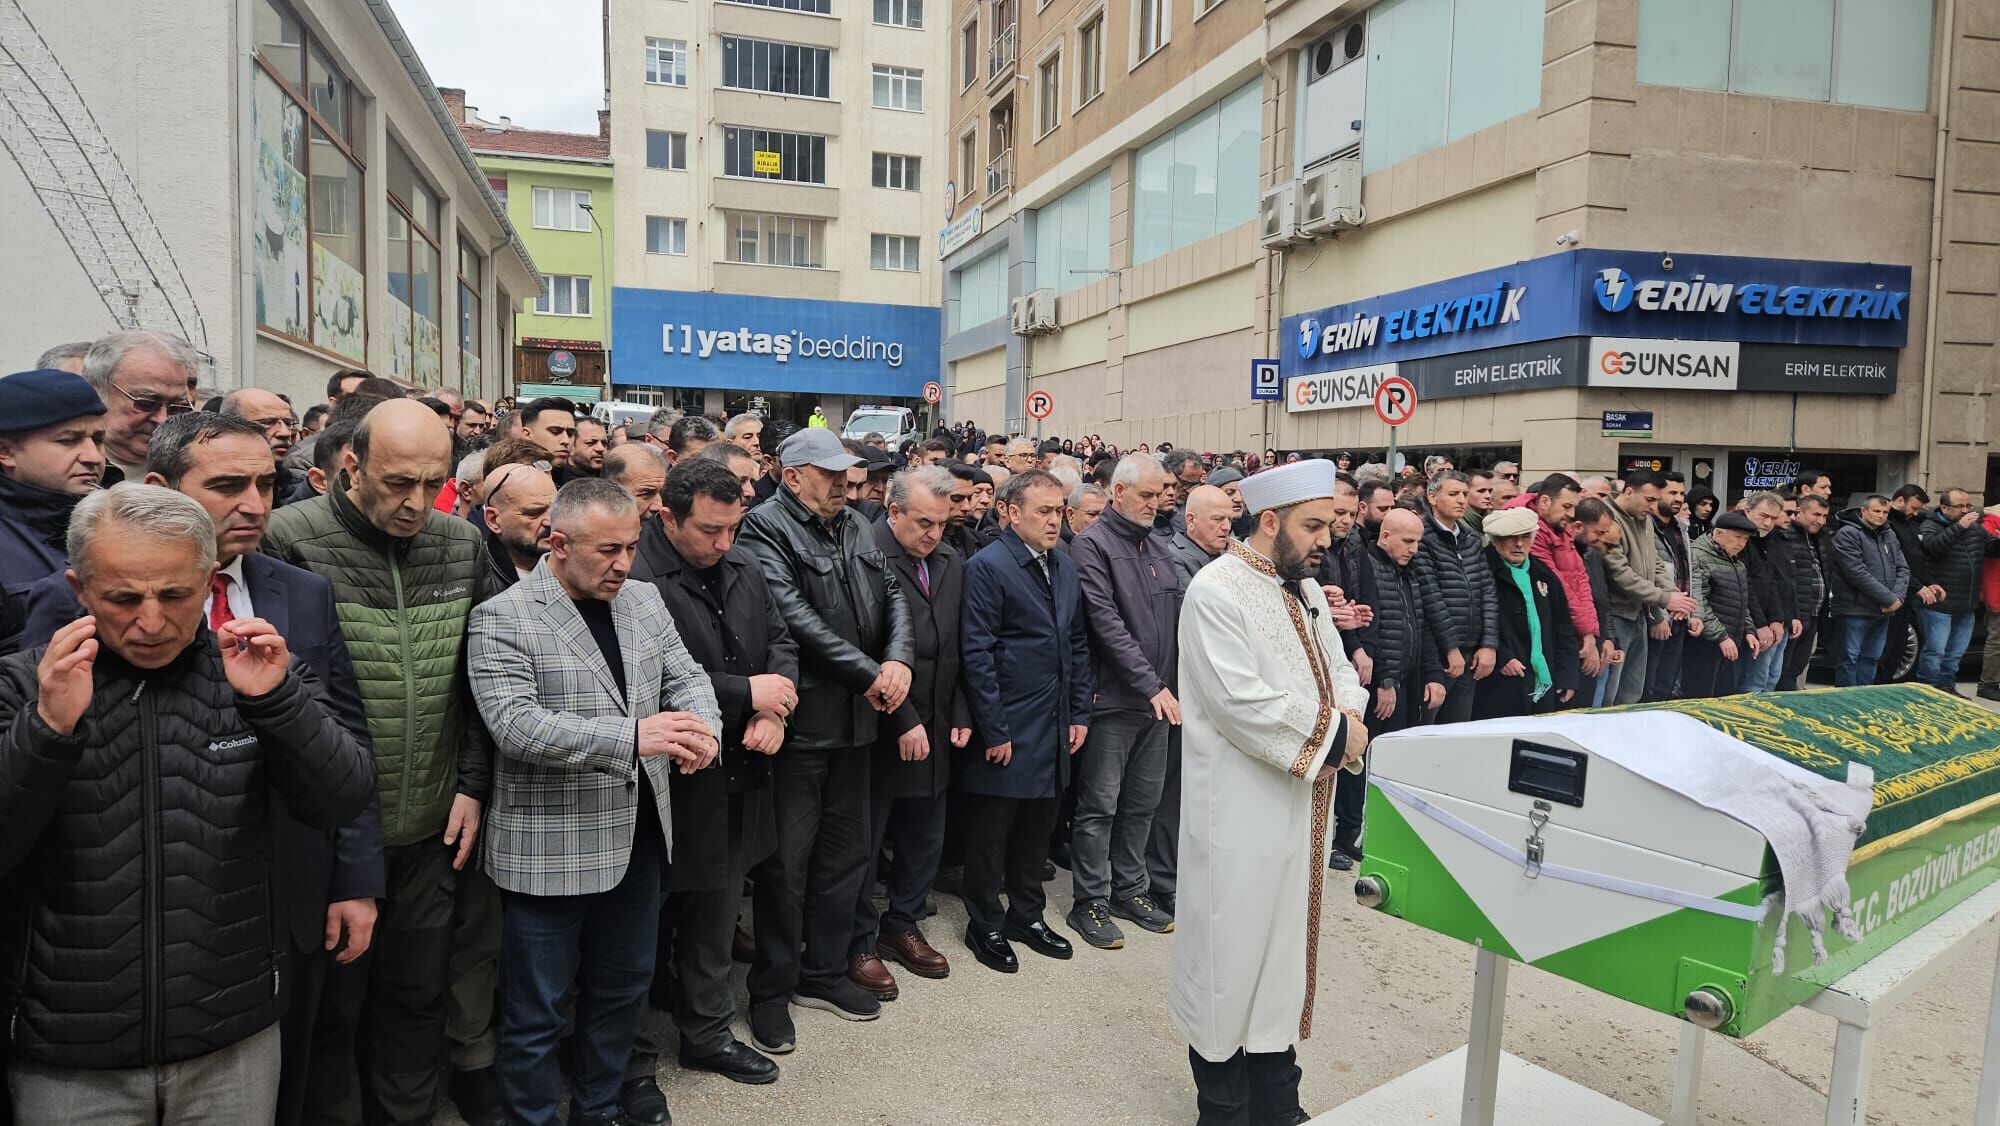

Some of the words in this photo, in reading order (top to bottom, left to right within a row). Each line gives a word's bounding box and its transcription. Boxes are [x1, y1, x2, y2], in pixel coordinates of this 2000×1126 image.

[1634, 274, 1733, 313] ERİM
[1736, 282, 1907, 321] ELEKTRİK
[1322, 312, 1380, 354] ERİM
[1384, 281, 1527, 343] ELEKTRİK
[697, 327, 793, 362] yataş
[798, 331, 903, 367] bedding
[1261, 367, 1275, 383] D
[1455, 364, 1488, 386] ERİM
[1491, 354, 1562, 381] ELEKTRİK
[1785, 361, 1820, 378] ERİM
[1823, 362, 1887, 379] ELEKTRİK
[1035, 397, 1047, 412] P
[1388, 387, 1405, 414] P
[1761, 459, 1801, 476] ERİM
[1886, 844, 1962, 921] BOZÜYÜK
